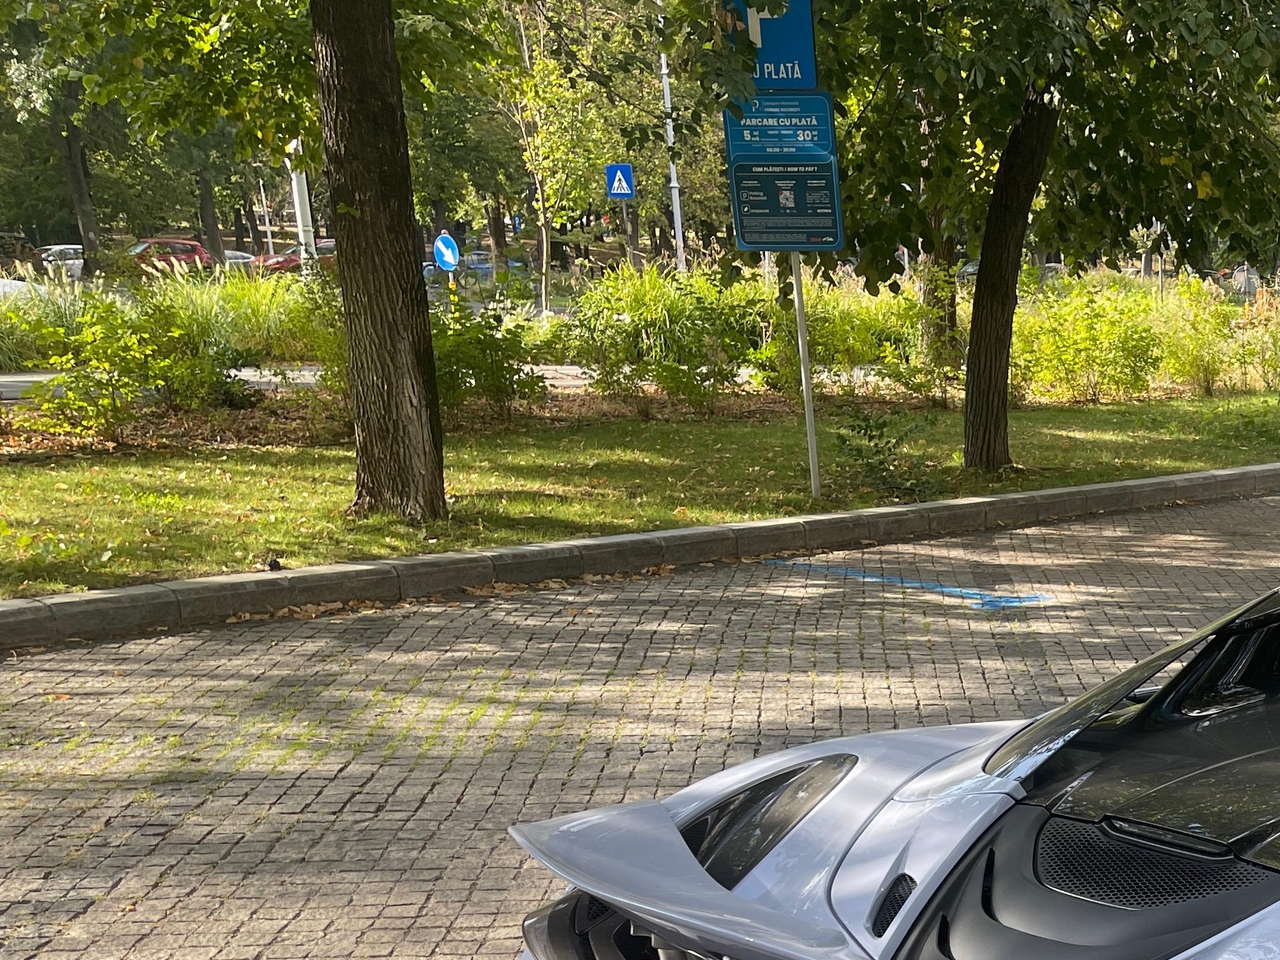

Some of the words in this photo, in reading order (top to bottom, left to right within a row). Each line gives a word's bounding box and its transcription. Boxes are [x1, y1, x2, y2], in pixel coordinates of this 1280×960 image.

[764, 61, 801, 79] PLATĂ
[740, 118, 778, 126] PARCARE
[779, 118, 791, 126] CU
[791, 116, 818, 126] PLATĂ
[743, 130, 751, 141] 5
[797, 130, 812, 141] 30
